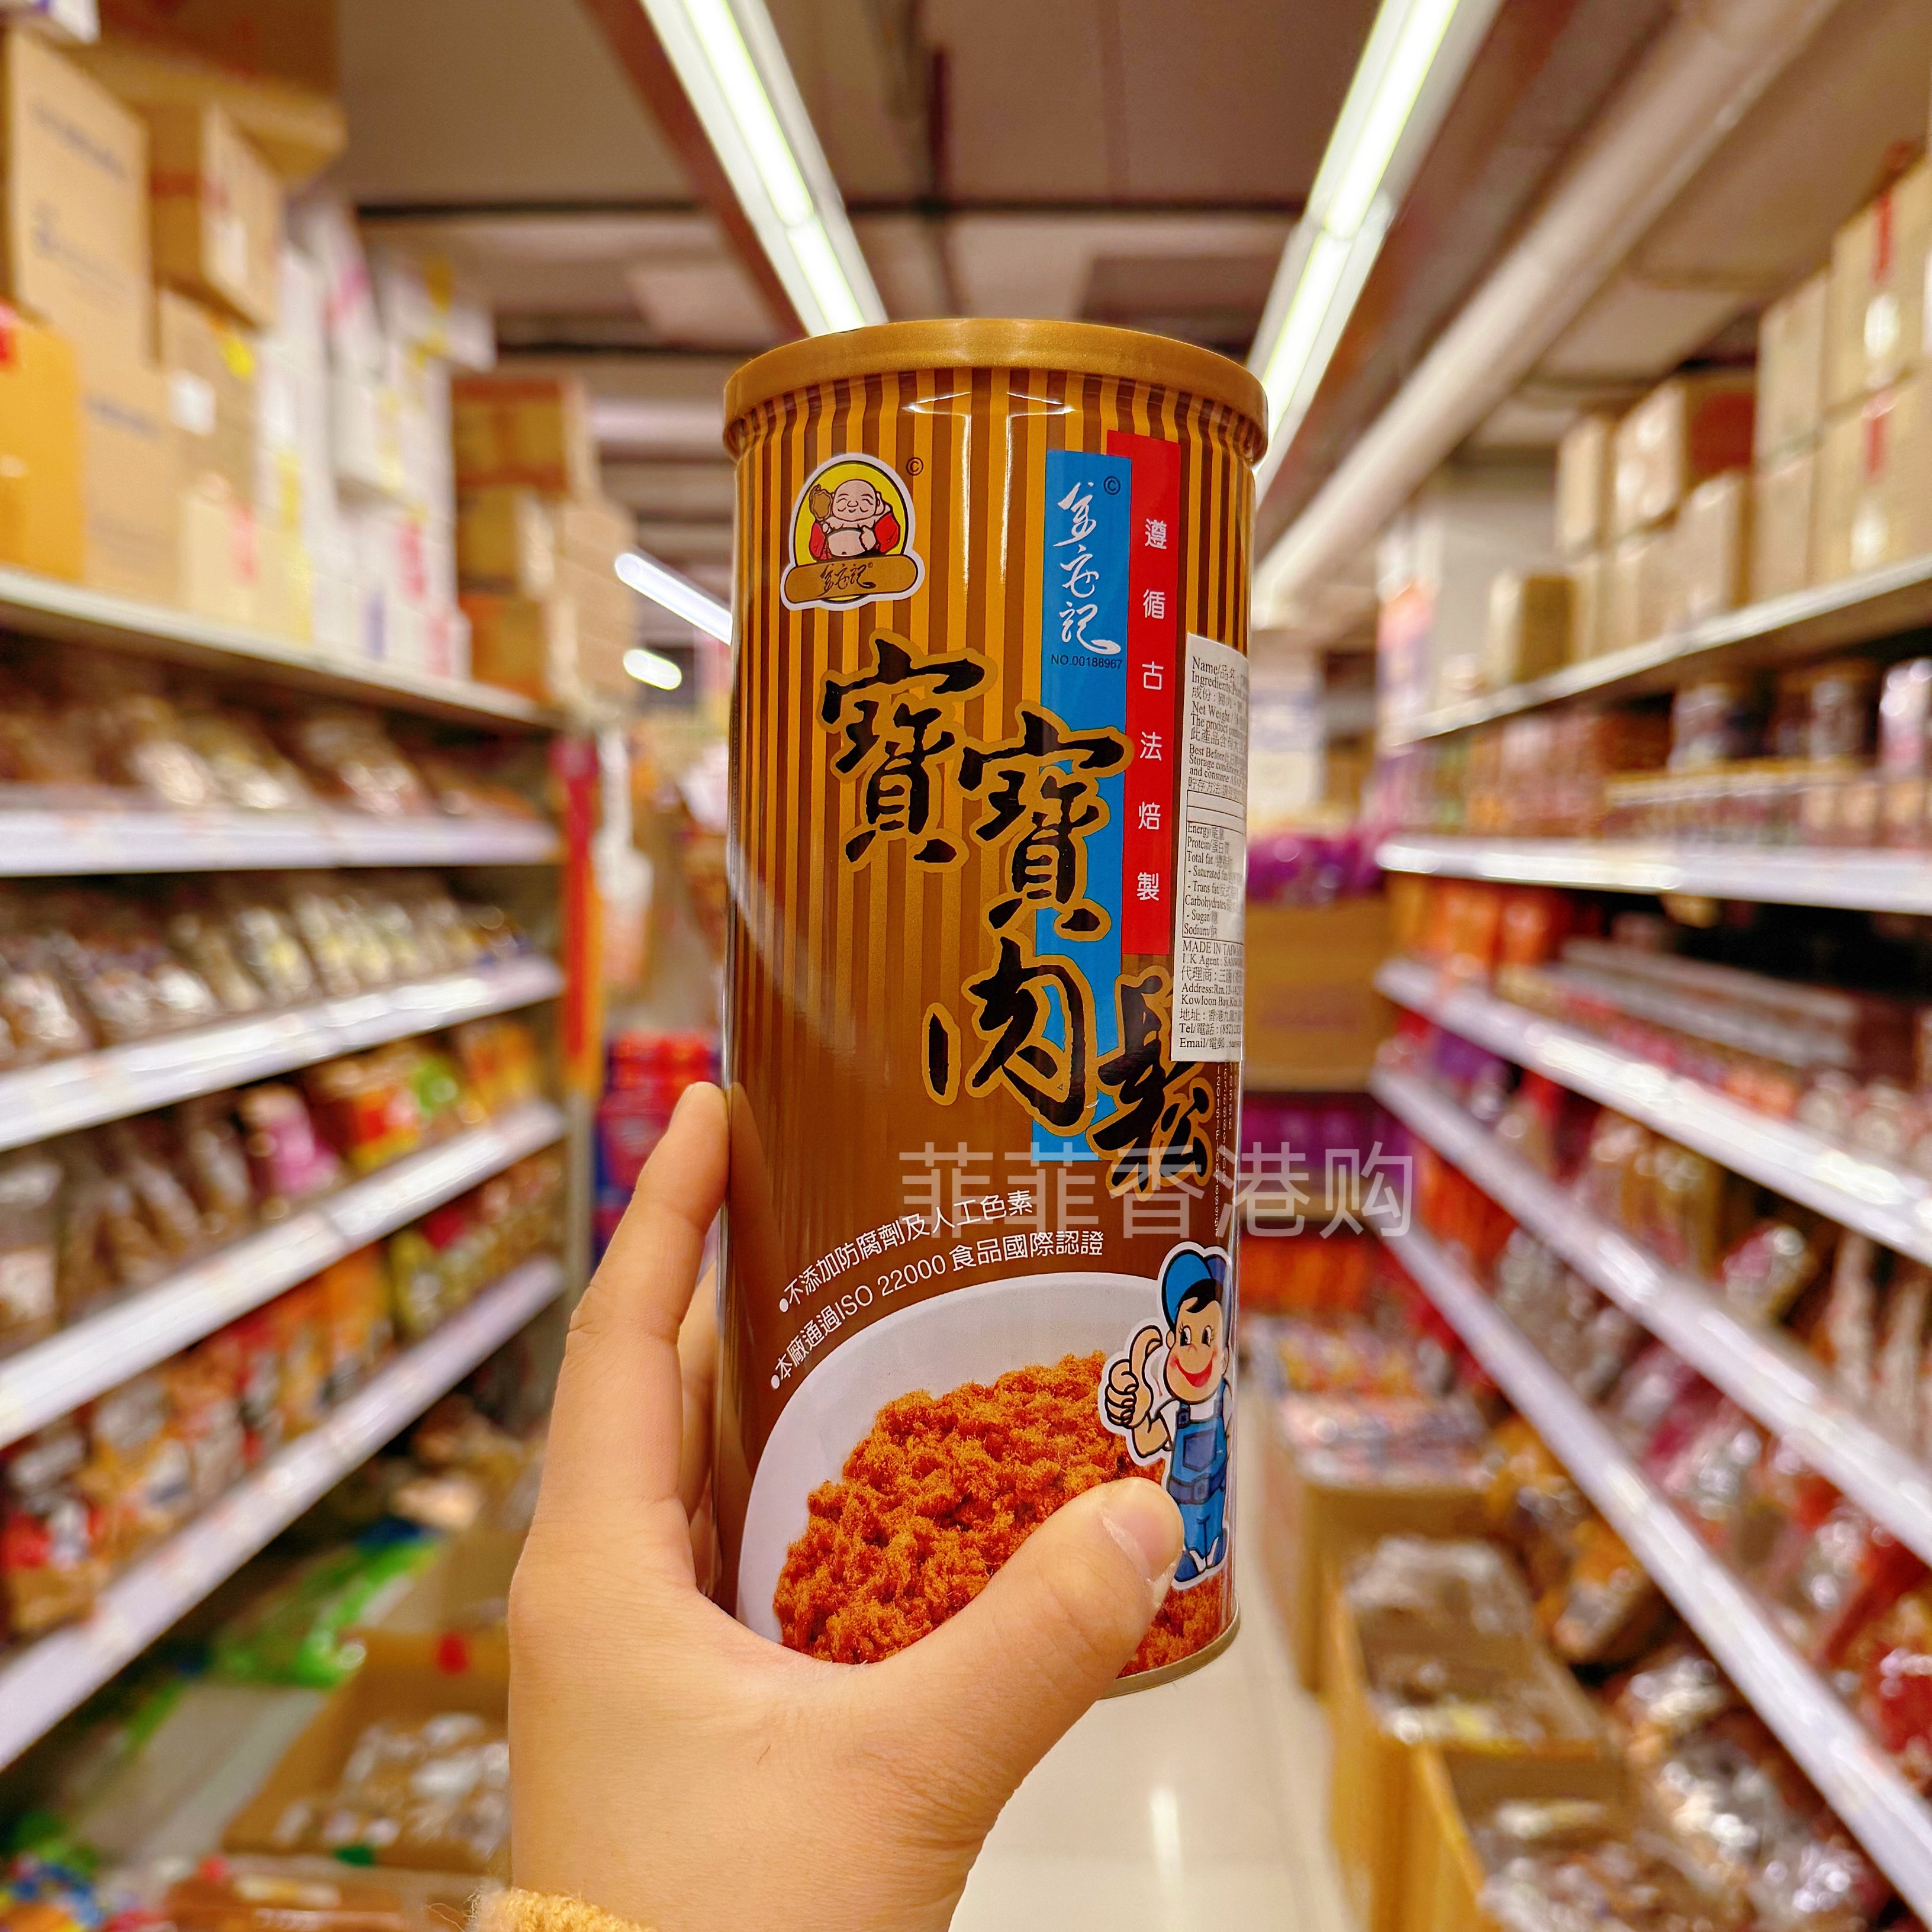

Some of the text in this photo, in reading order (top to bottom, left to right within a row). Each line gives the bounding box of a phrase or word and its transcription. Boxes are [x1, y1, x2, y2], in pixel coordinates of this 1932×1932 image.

[1051, 655, 1123, 669] NO.00188967
[1136, 519, 1167, 901] 遵循古法焙製
[1192, 700, 1206, 715] Net
[1191, 713, 1205, 727] The
[1189, 744, 1204, 755] Best
[1189, 754, 1215, 770] Storage
[1189, 768, 1202, 777] and
[1187, 851, 1204, 864] Total
[1193, 865, 1221, 880] Saturated
[1193, 880, 1210, 893] Trans
[1183, 940, 1211, 954] MADE
[1213, 943, 1221, 954] IN
[1181, 995, 1216, 1006] Kowloon
[783, 1189, 1033, 1306] 不添加防腐劑及人工色素
[774, 1229, 1104, 1381] 本廠通過ISO 22000 食品國際認證
